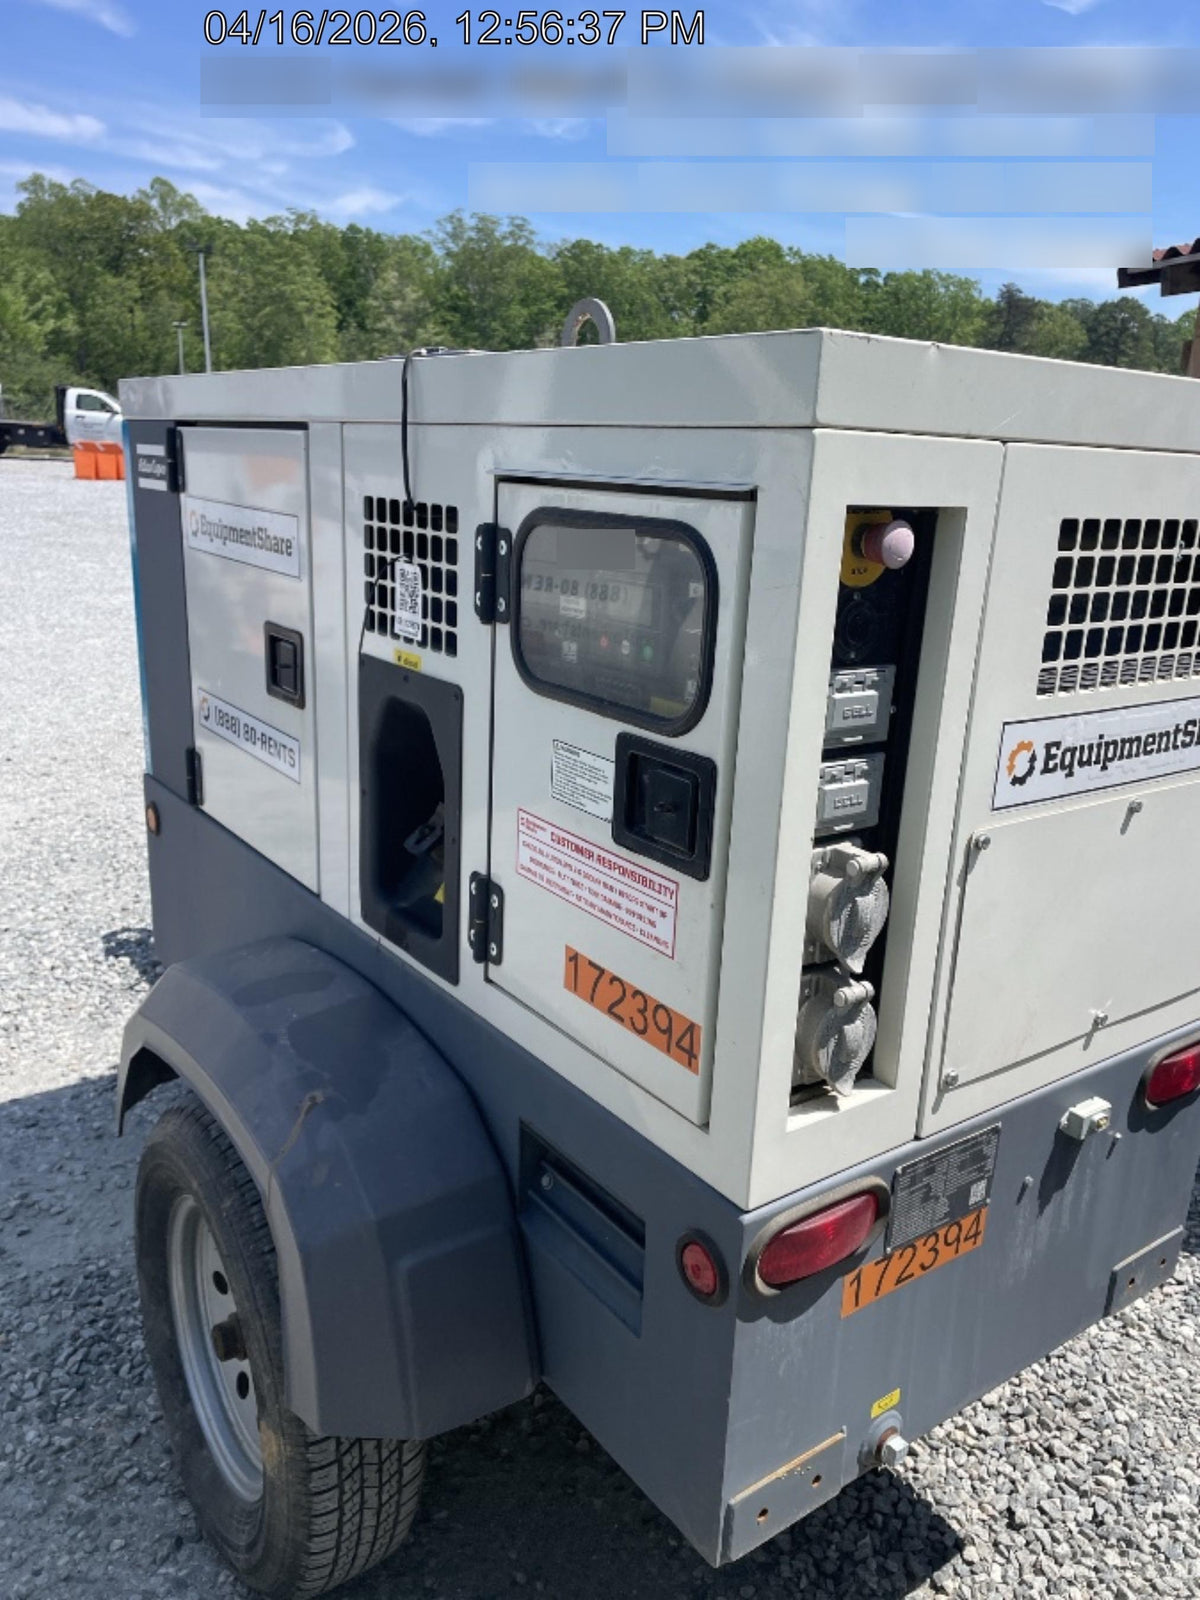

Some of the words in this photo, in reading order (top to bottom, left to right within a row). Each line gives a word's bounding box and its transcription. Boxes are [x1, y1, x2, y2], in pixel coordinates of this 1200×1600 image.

[201, 514, 293, 557] EquipmentShare
[214, 705, 240, 738] (888)
[243, 723, 296, 769] 80-RENTS
[1040, 717, 1200, 780] EquipmentS
[550, 831, 595, 863] CUSTOMER
[596, 852, 675, 900] RESPONSIBILITY
[568, 951, 697, 1069] 172394
[850, 1209, 982, 1307] 172394
